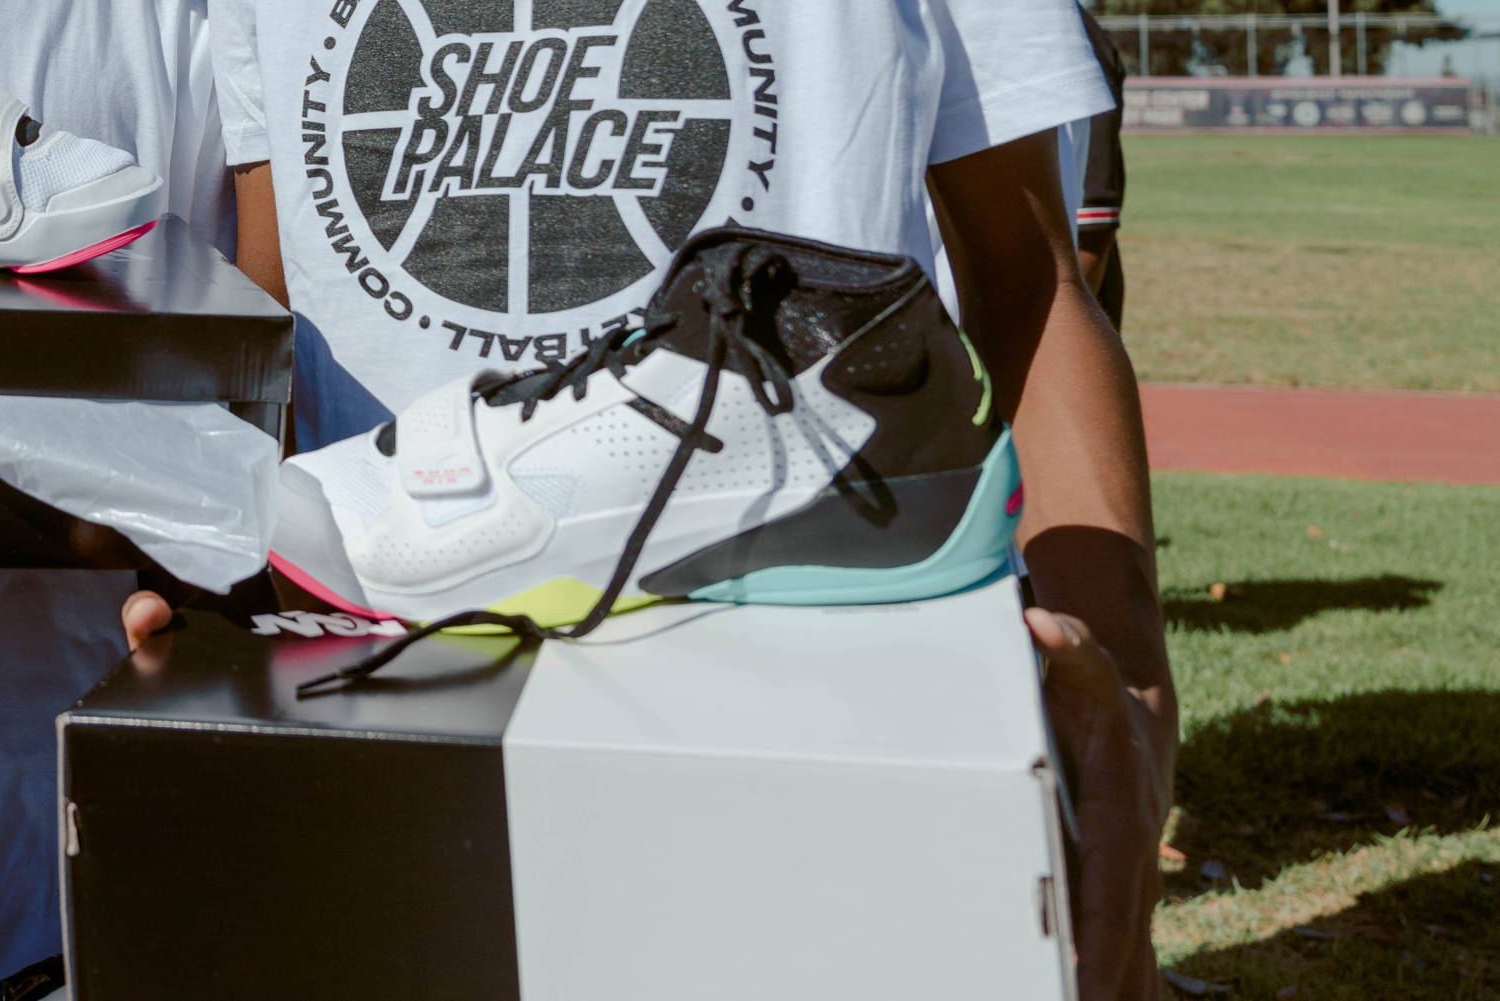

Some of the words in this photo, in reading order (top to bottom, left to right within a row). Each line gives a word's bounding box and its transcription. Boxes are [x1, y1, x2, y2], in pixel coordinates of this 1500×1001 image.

[417, 34, 618, 118] SHOE
[301, 55, 413, 321] COMMUNITY
[392, 108, 680, 195] PALACE
